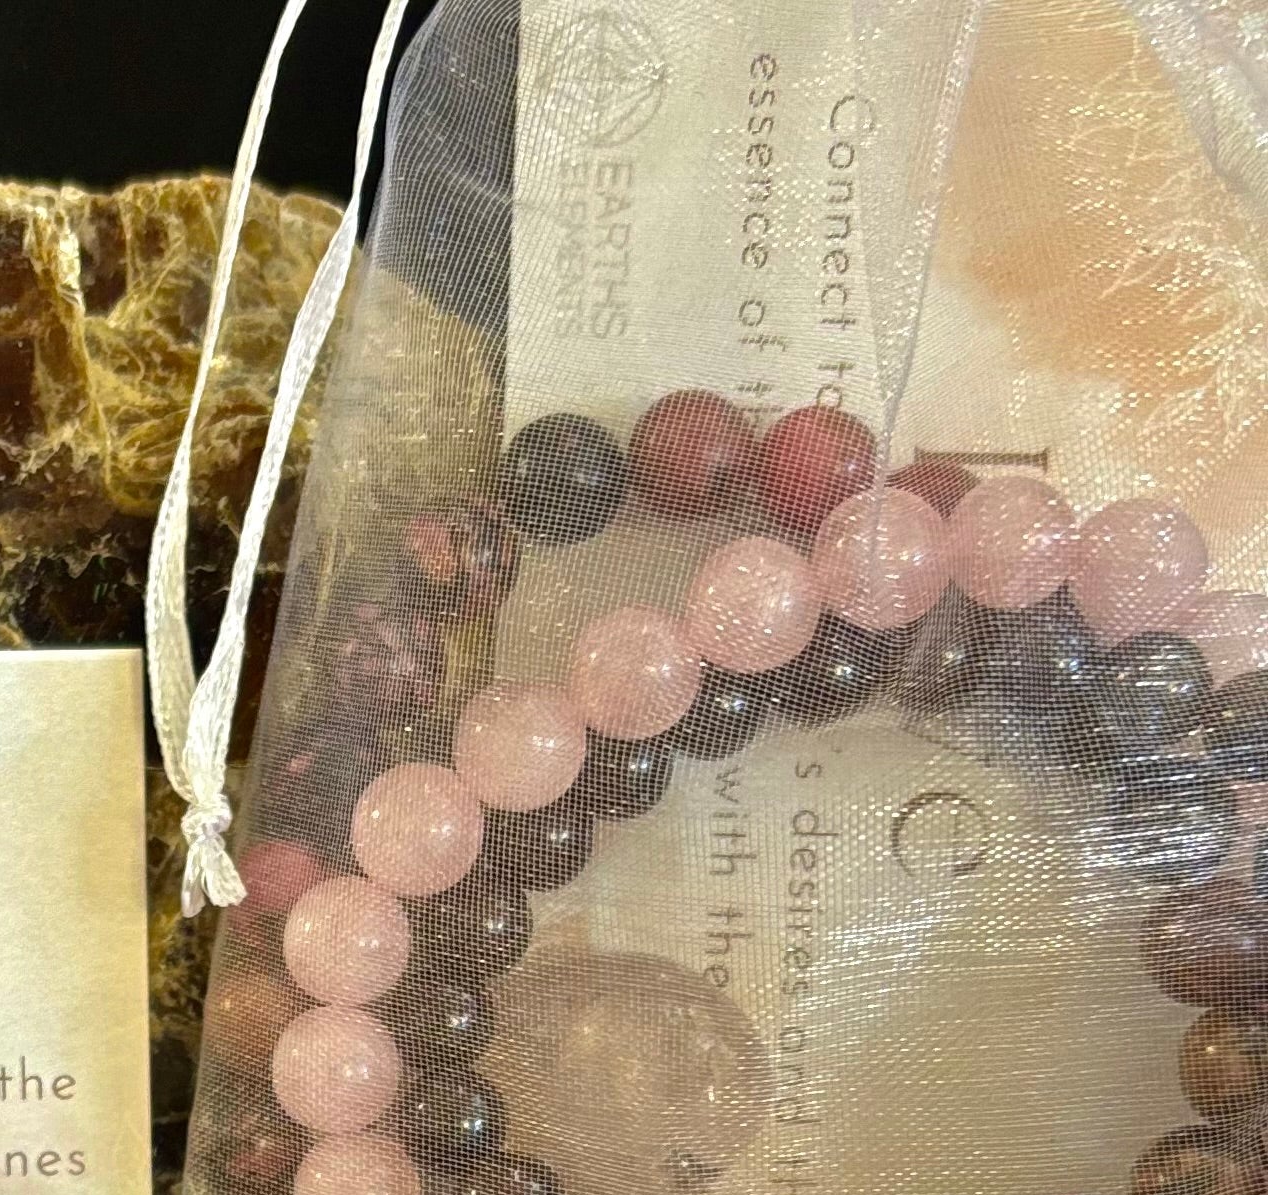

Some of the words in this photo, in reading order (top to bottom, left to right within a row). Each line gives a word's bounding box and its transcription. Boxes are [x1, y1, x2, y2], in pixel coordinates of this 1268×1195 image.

[593, 160, 634, 341] EARTHS
[740, 52, 779, 270] essence
[818, 93, 876, 332] Connect
[737, 299, 788, 353] of
[707, 768, 756, 878] with
[785, 808, 840, 998] desires
